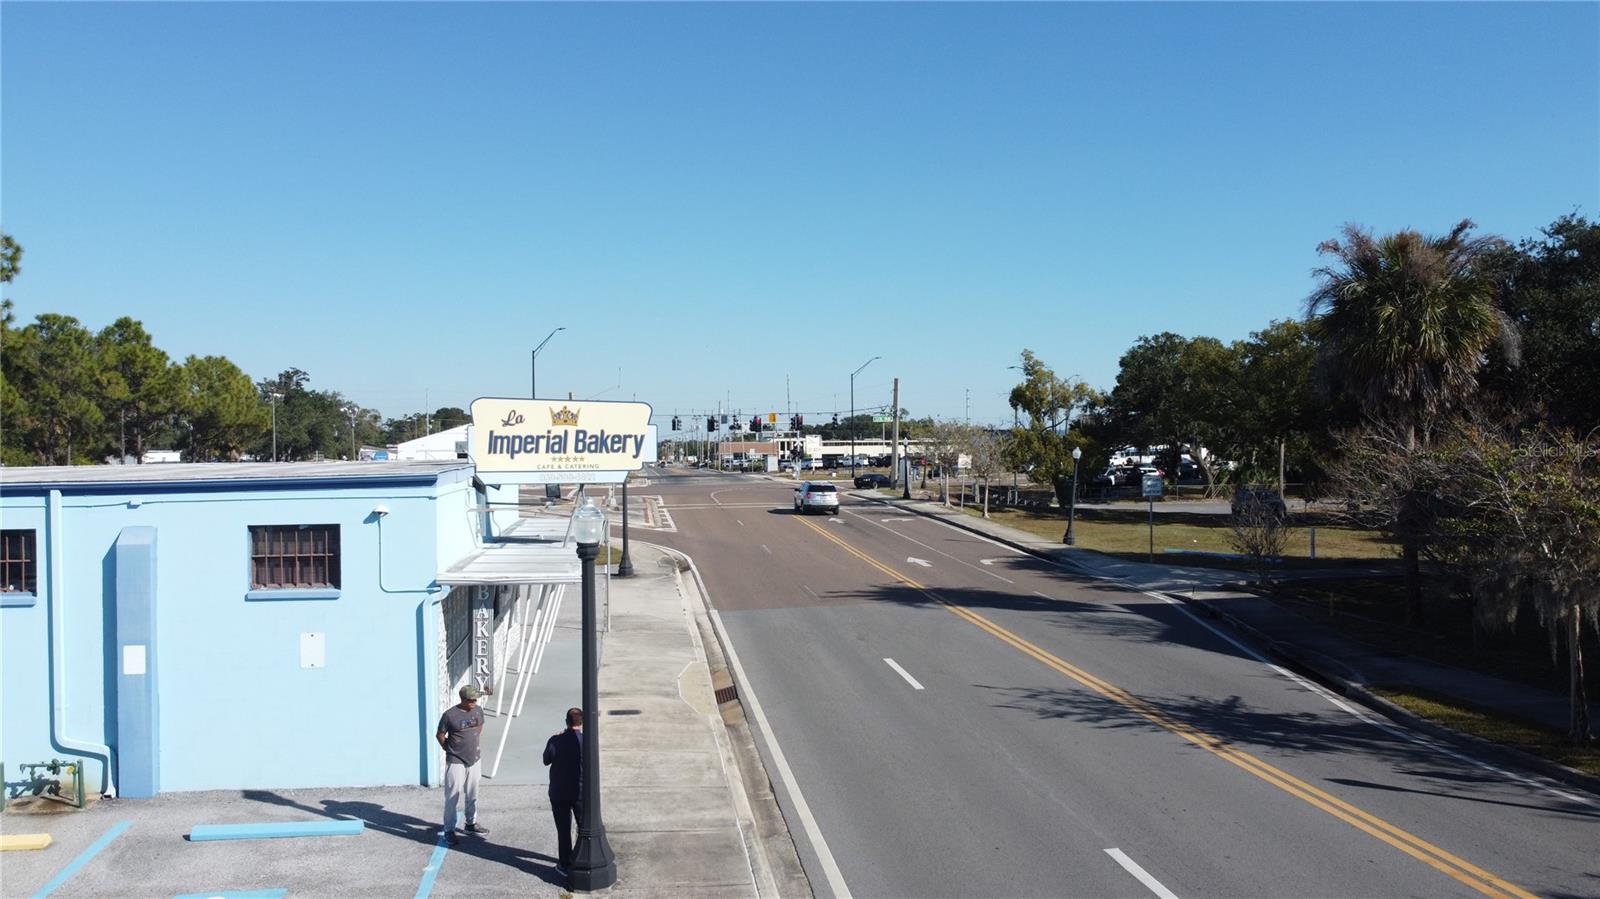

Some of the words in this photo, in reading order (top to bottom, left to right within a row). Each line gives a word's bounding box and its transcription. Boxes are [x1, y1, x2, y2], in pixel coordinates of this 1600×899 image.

[501, 409, 525, 427] La
[488, 429, 569, 459] Imperial
[574, 429, 646, 459] Bakery
[475, 584, 490, 693] BAKERY
